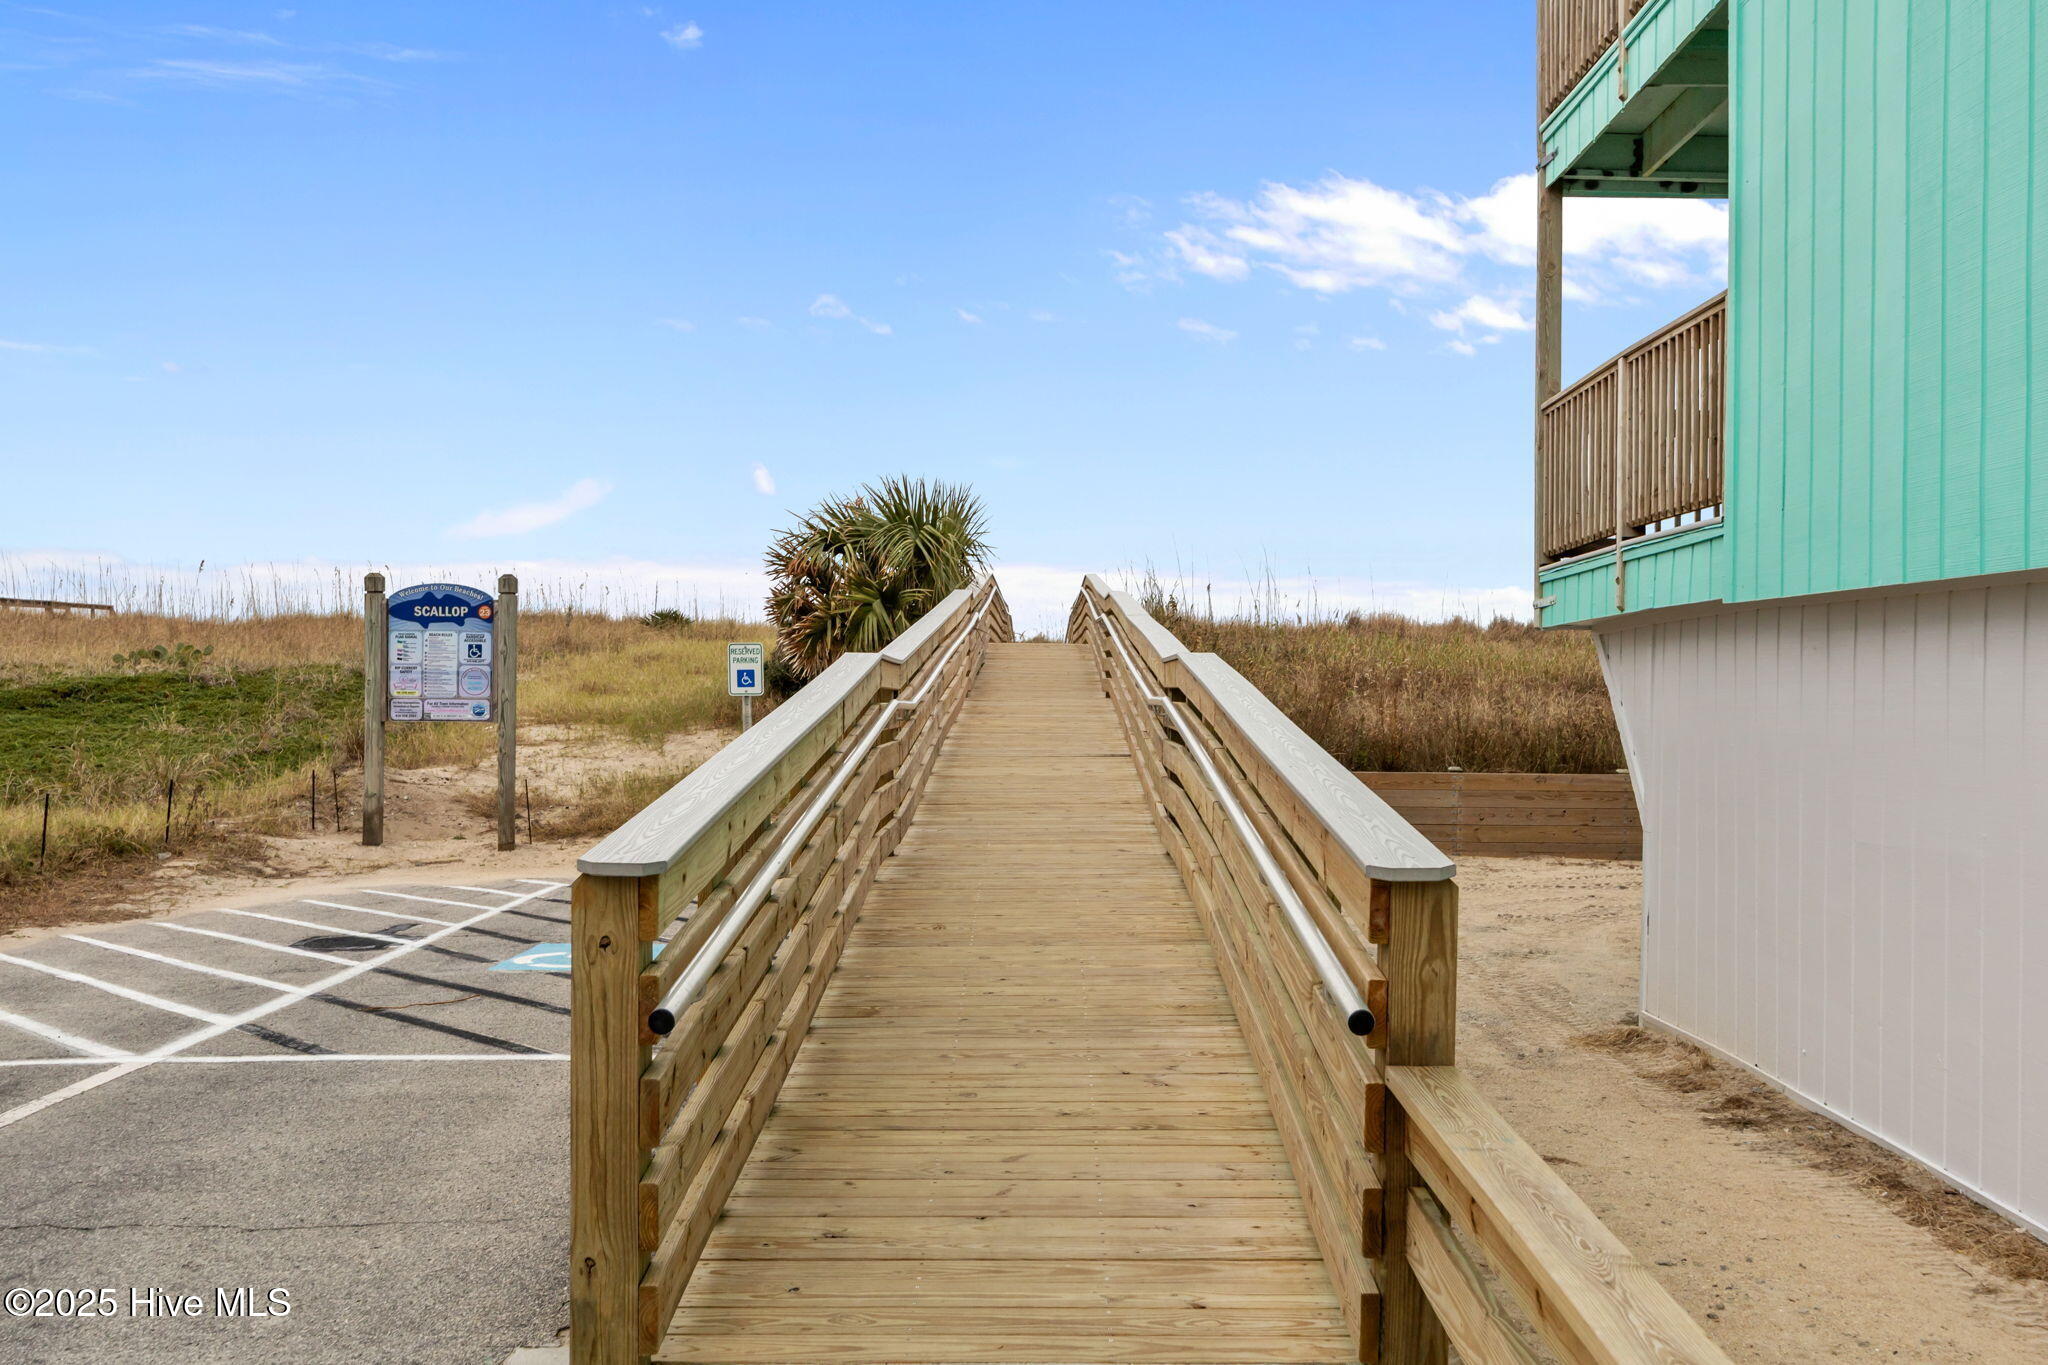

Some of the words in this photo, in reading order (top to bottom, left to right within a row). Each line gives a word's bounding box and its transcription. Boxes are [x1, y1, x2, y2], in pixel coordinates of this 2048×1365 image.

[398, 586, 429, 598] Welcome
[454, 586, 484, 600] Beaches!
[414, 606, 468, 617] SCALLOP
